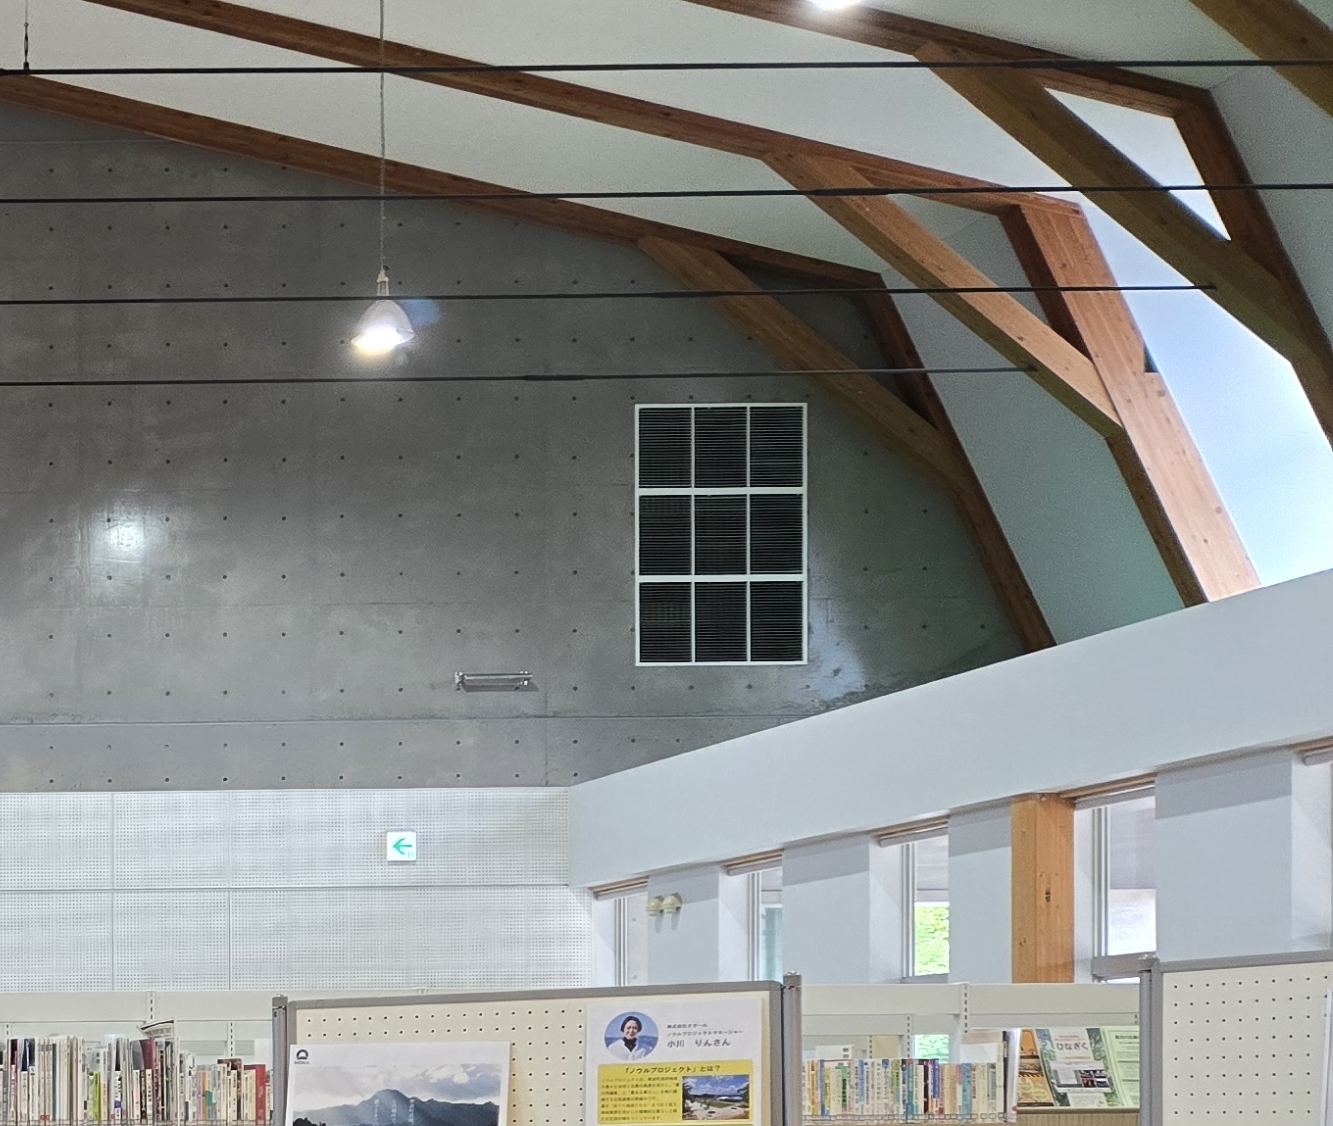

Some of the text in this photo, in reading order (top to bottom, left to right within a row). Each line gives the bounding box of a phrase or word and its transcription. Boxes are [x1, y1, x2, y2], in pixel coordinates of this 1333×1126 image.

[667, 1038, 731, 1048] 小川 りんさん
